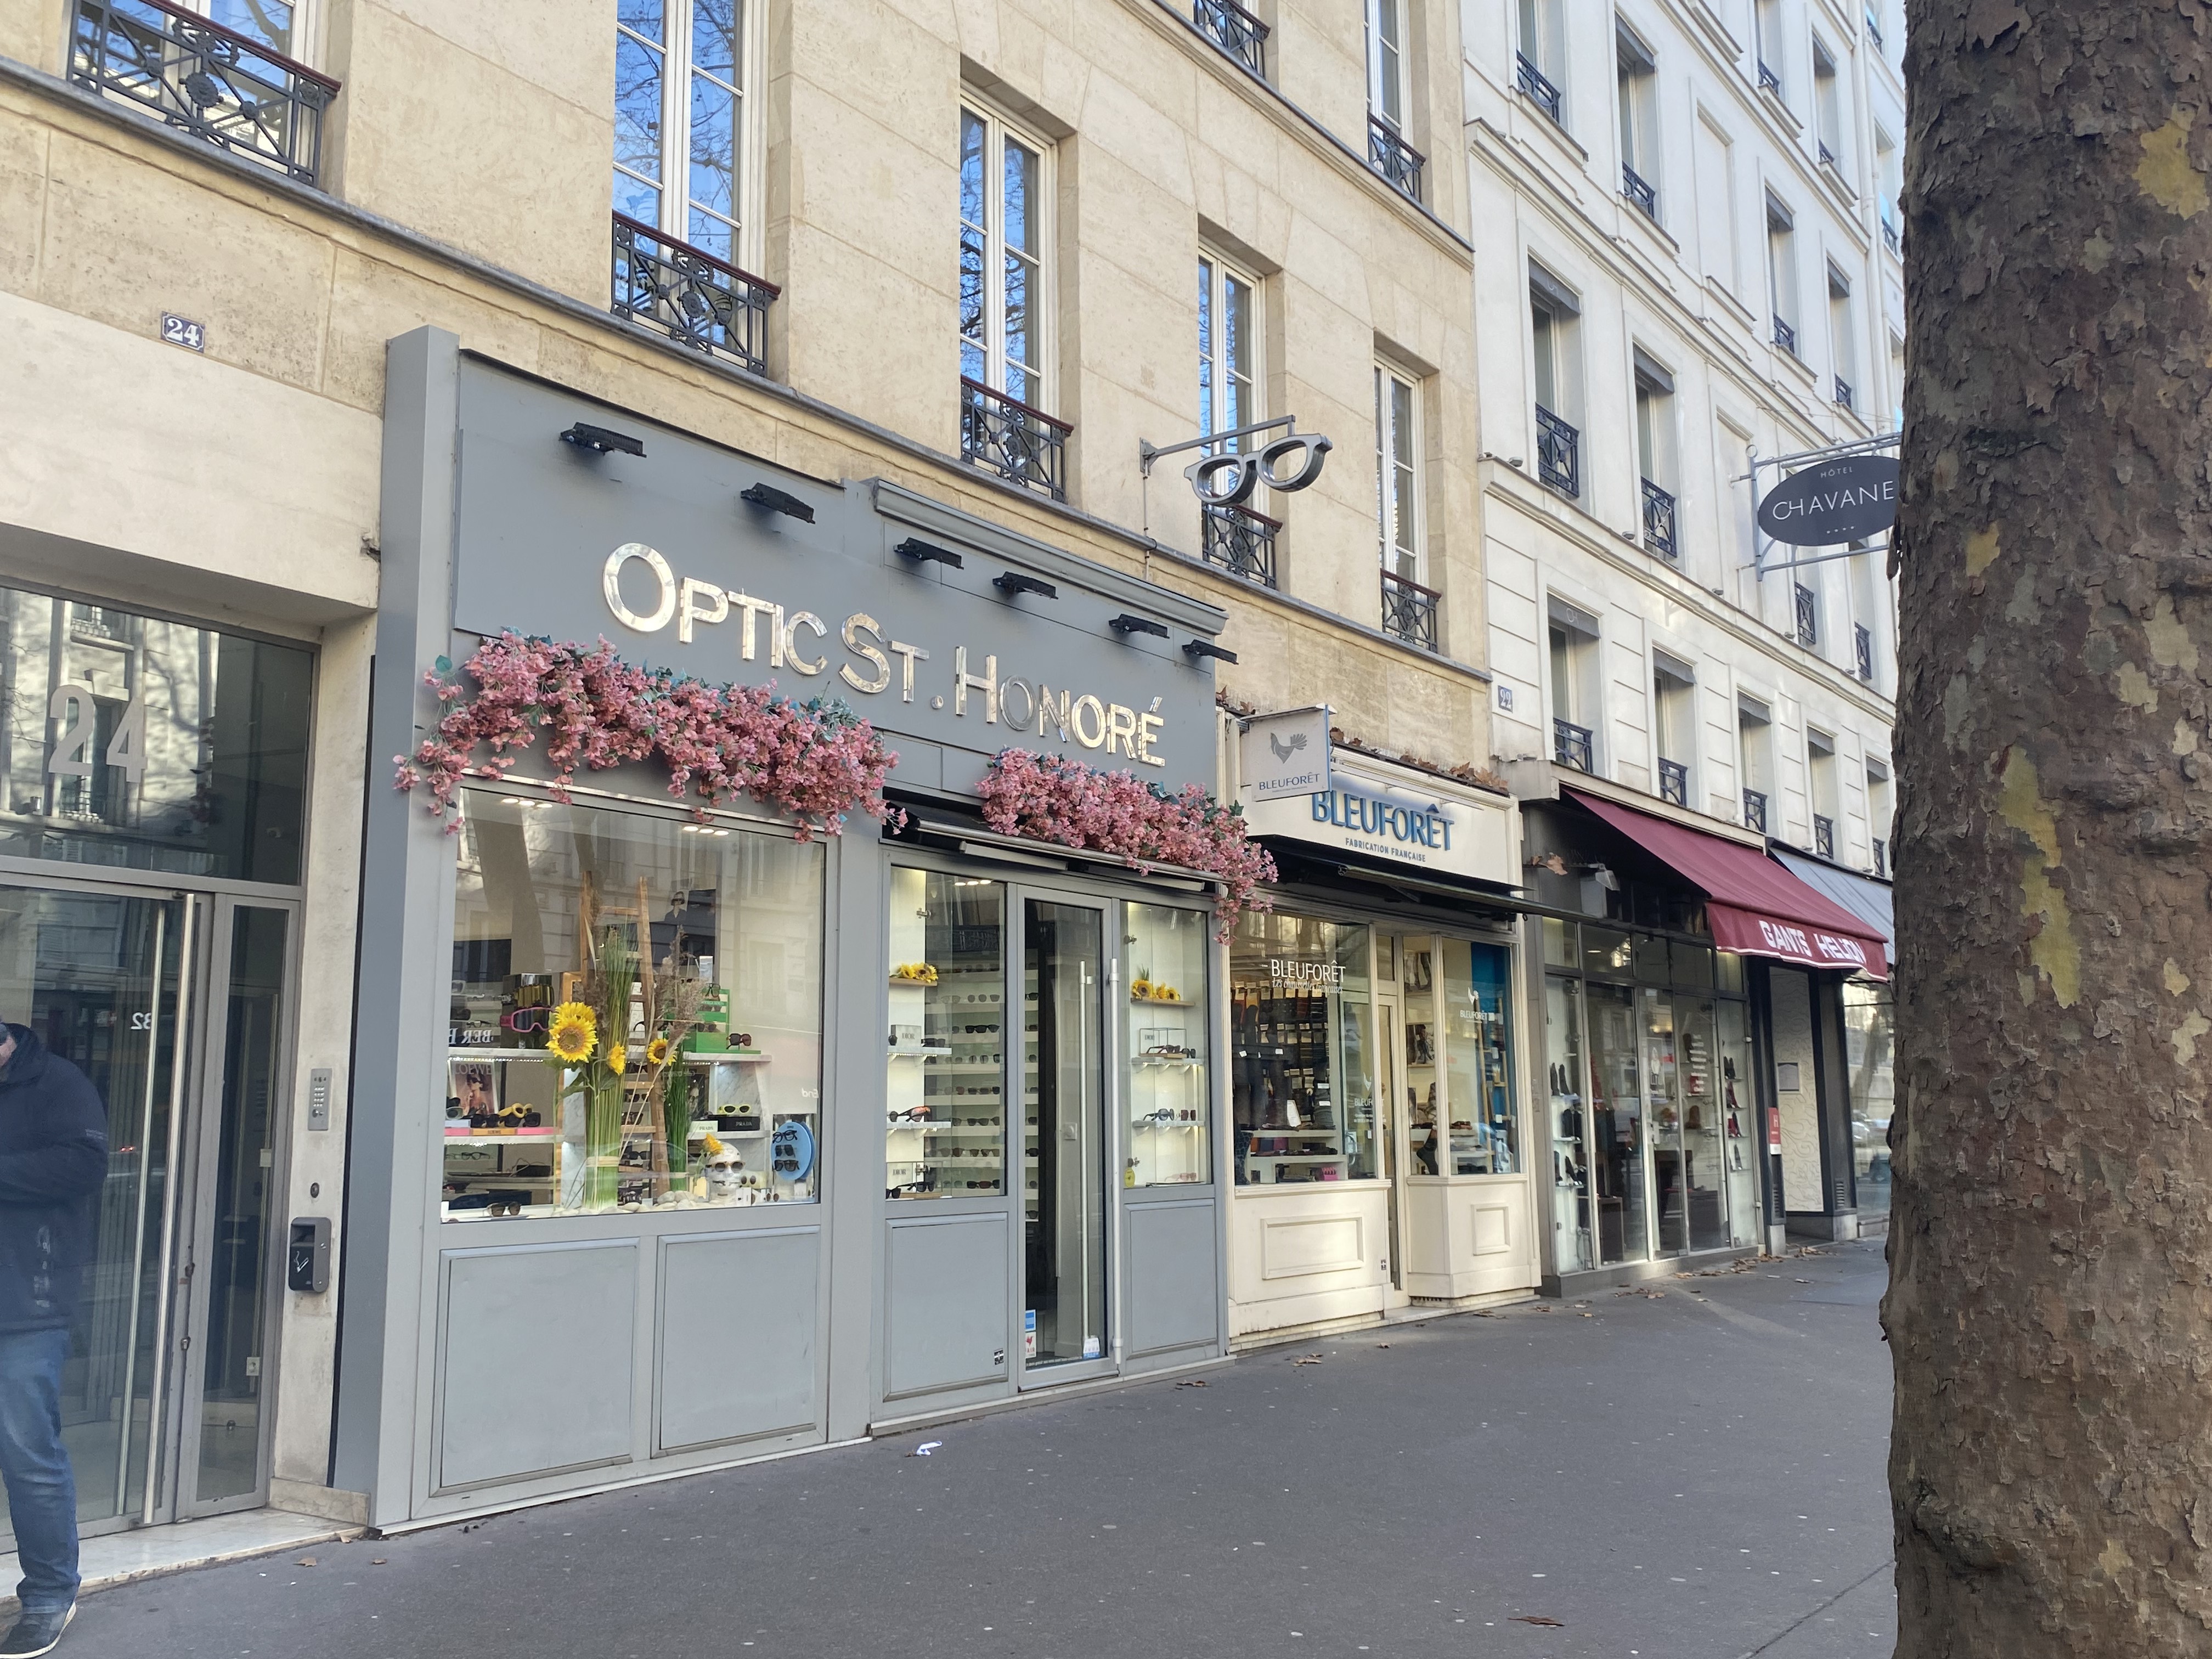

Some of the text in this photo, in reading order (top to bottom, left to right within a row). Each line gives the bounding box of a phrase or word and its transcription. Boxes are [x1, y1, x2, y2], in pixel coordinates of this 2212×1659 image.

[166, 318, 200, 346] 24
[1820, 466, 1853, 478] HÔTEL
[1772, 480, 1894, 521] CHAVANE
[602, 542, 828, 676] OPTIC
[955, 645, 1166, 766] HONORÉ
[1500, 689, 1511, 709] 22
[49, 685, 148, 783] 24
[1259, 772, 1321, 791] BLEUFORÊT
[1312, 791, 1455, 851] BLEUFORÊT
[1345, 837, 1426, 863] FABRICATION FRANÇAISE
[1759, 920, 1813, 957] GANTS
[1271, 958, 1346, 983] BLEUFORÊT
[1460, 1009, 1488, 1020] BLEUFORÊT
